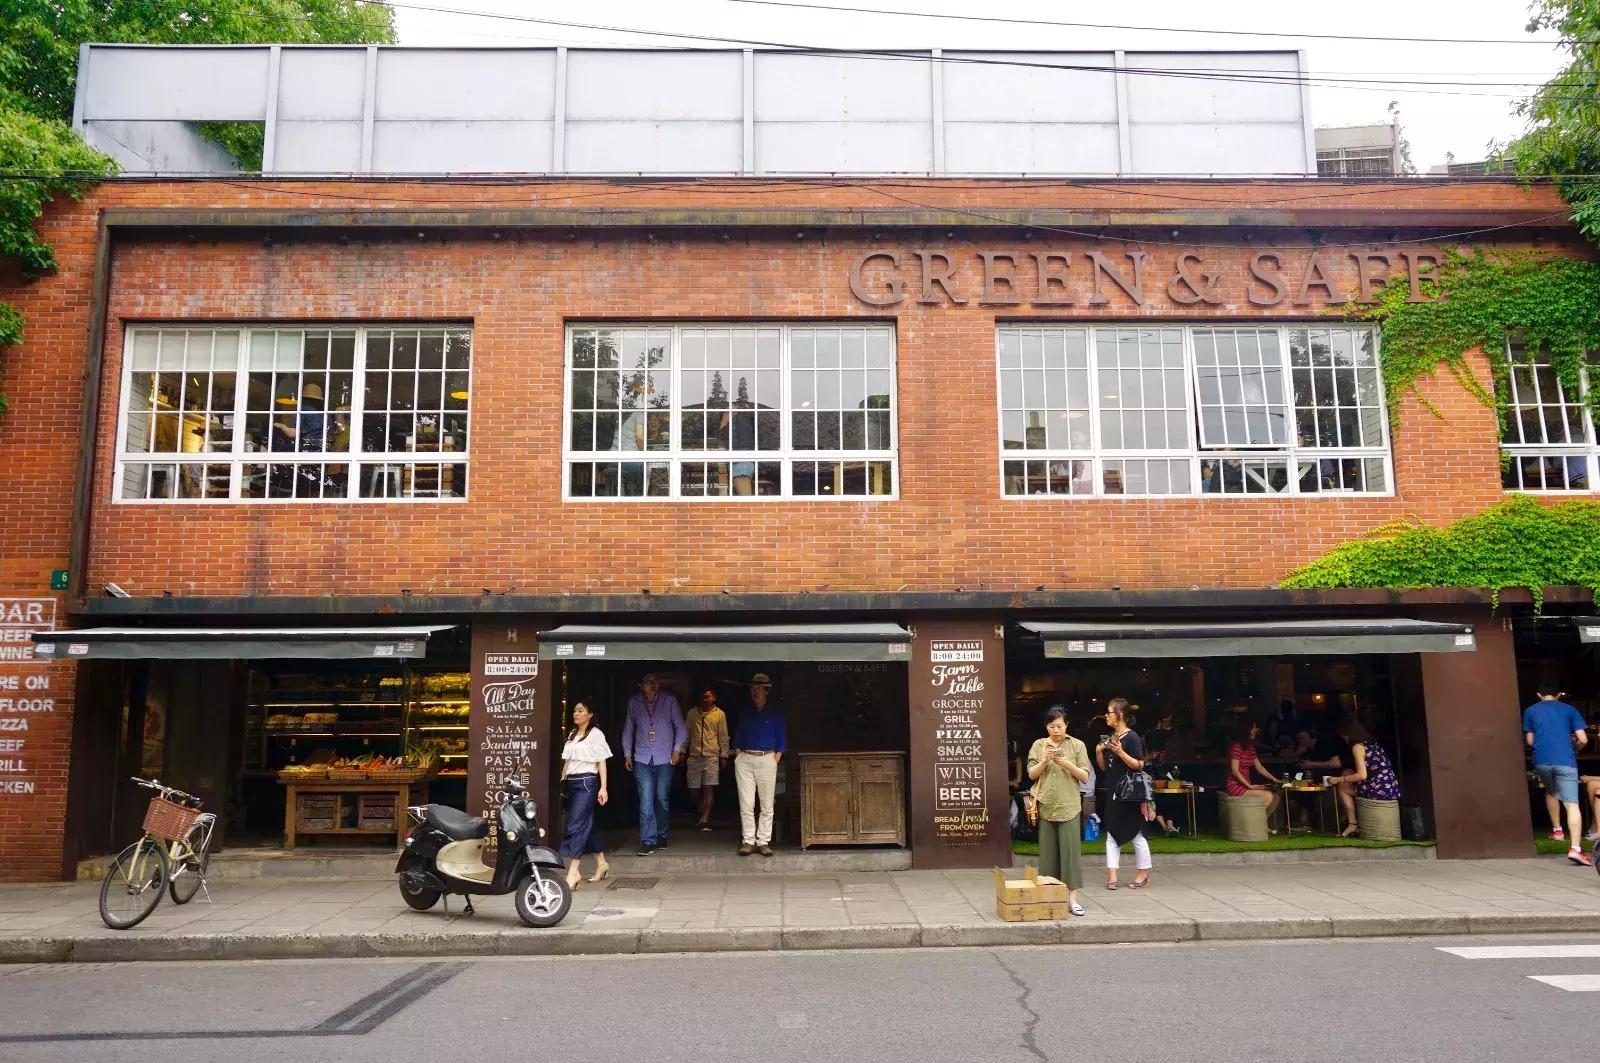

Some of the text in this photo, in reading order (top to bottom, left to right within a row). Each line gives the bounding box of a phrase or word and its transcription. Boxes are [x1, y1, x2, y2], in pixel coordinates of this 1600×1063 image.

[849, 250, 1449, 306] GREEN & SAFE
[931, 664, 979, 686] Farm
[25, 675, 50, 690] ON
[943, 677, 985, 696] table
[508, 683, 536, 701] Day
[0, 699, 54, 712] FLOOR
[486, 698, 534, 713] BRUNCH
[932, 699, 984, 709] GROCERY
[0, 718, 28, 730] ZZA
[944, 715, 973, 723] GRILL
[486, 725, 533, 734] SALAD
[936, 729, 982, 739] PIZZA
[937, 745, 982, 756] SNACK
[485, 756, 531, 766] PASTA
[486, 773, 530, 785] RIE
[939, 766, 983, 779] WINE
[939, 787, 982, 800] BEER
[960, 808, 990, 828] fresh
